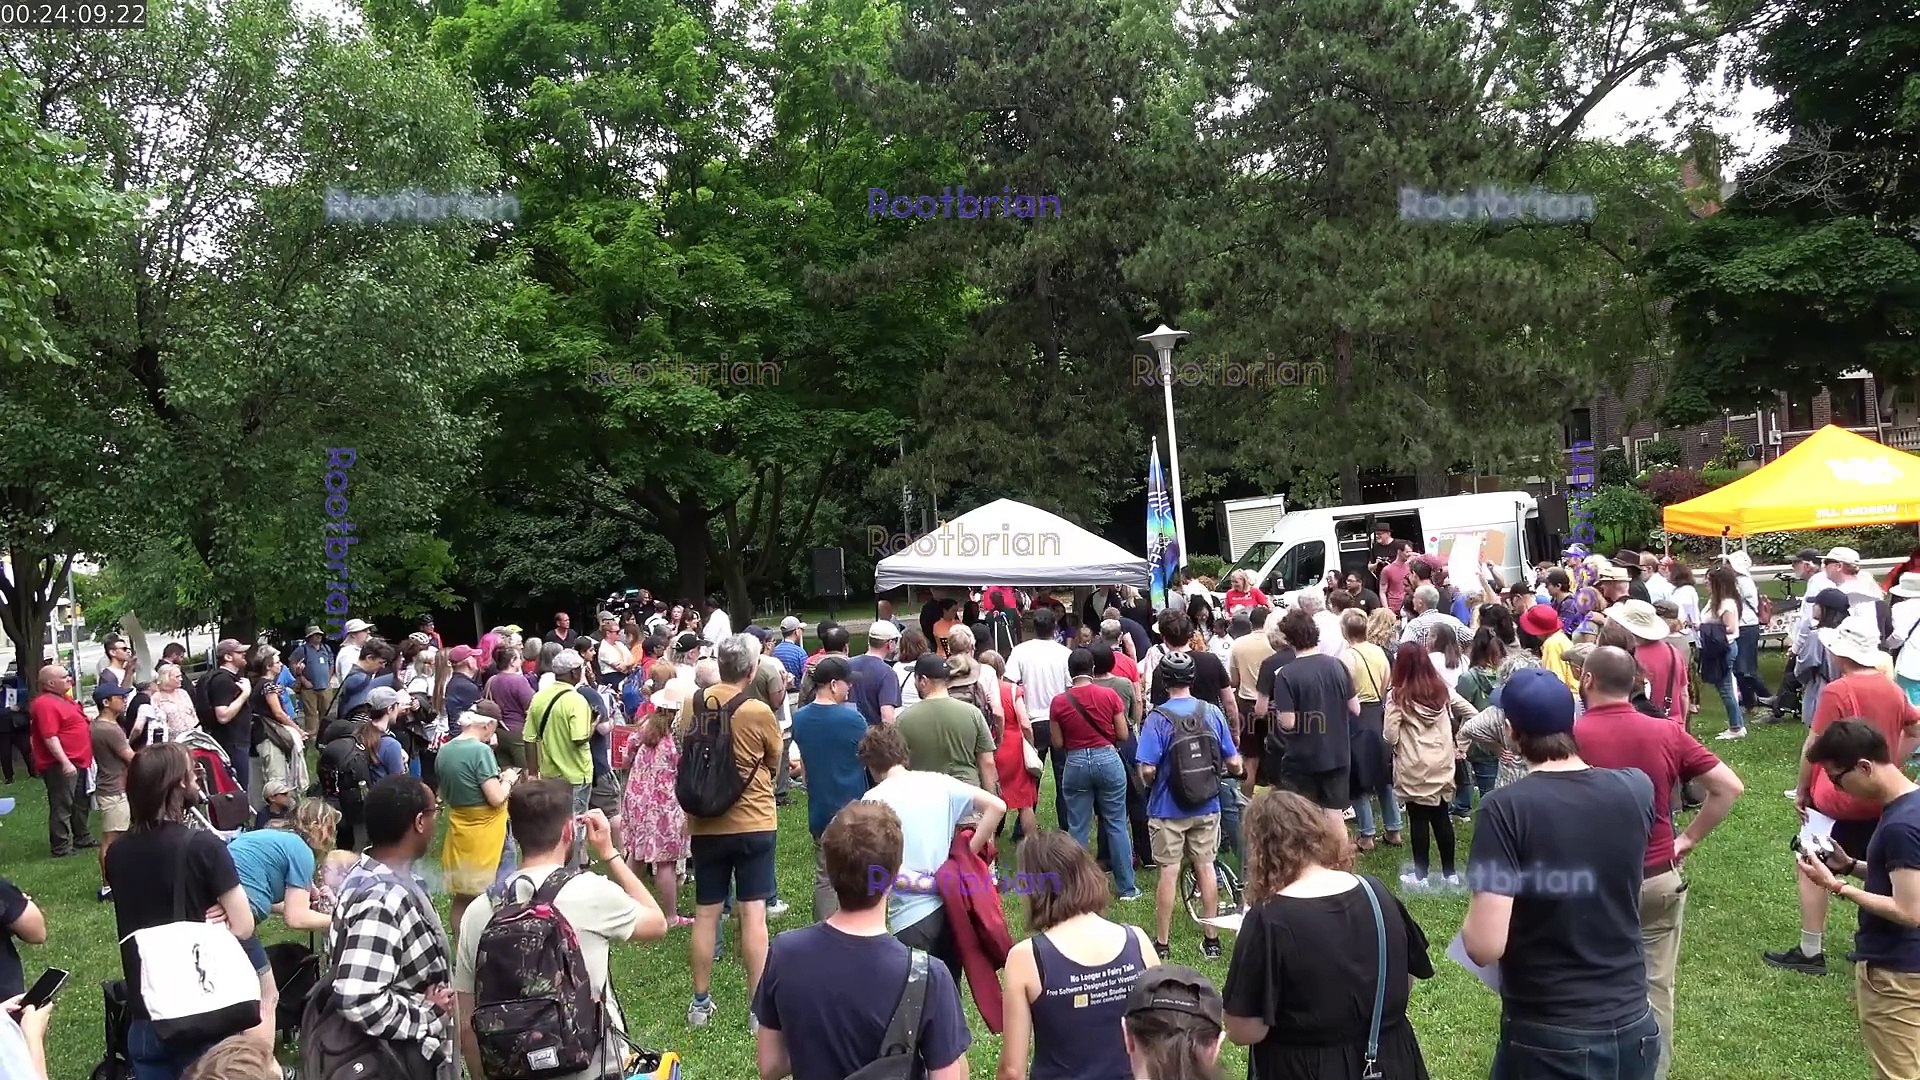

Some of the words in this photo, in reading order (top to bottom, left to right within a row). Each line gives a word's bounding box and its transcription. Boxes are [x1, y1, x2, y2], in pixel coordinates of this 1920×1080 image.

[1070, 973, 1080, 983] No
[1080, 971, 1102, 983] Longer
[1107, 966, 1123, 977] Fairy
[1122, 963, 1135, 973] Tale
[1059, 985, 1083, 996] Software
[1083, 980, 1109, 991] Designed
[1108, 977, 1117, 986] for
